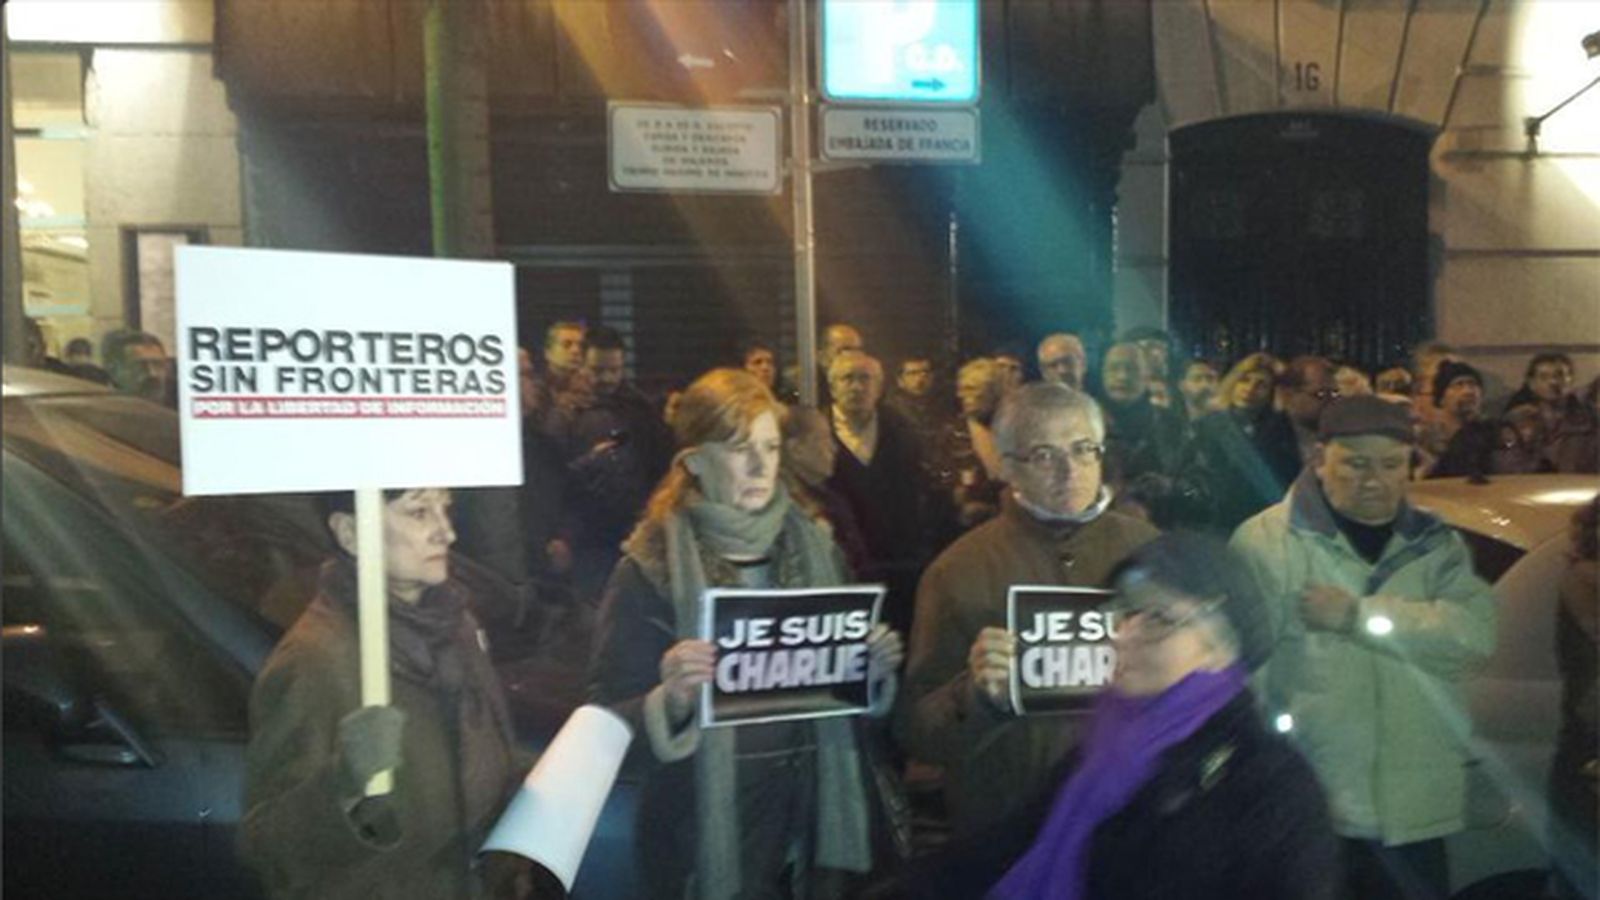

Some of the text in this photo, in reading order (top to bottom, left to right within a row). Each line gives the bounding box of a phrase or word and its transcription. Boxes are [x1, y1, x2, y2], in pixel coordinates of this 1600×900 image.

[863, 118, 938, 132] RESERVADO
[829, 136, 971, 151] EMBAJADA DE FRANCIA
[188, 327, 504, 365] REPORTEROS
[190, 365, 506, 394] SIN FRONTERAS
[192, 400, 235, 414] POR
[238, 400, 264, 414] LA
[361, 400, 383, 414] DE
[718, 609, 870, 648] JE SUIS
[1020, 611, 1075, 642] JE
[716, 642, 868, 692] CHARLIE
